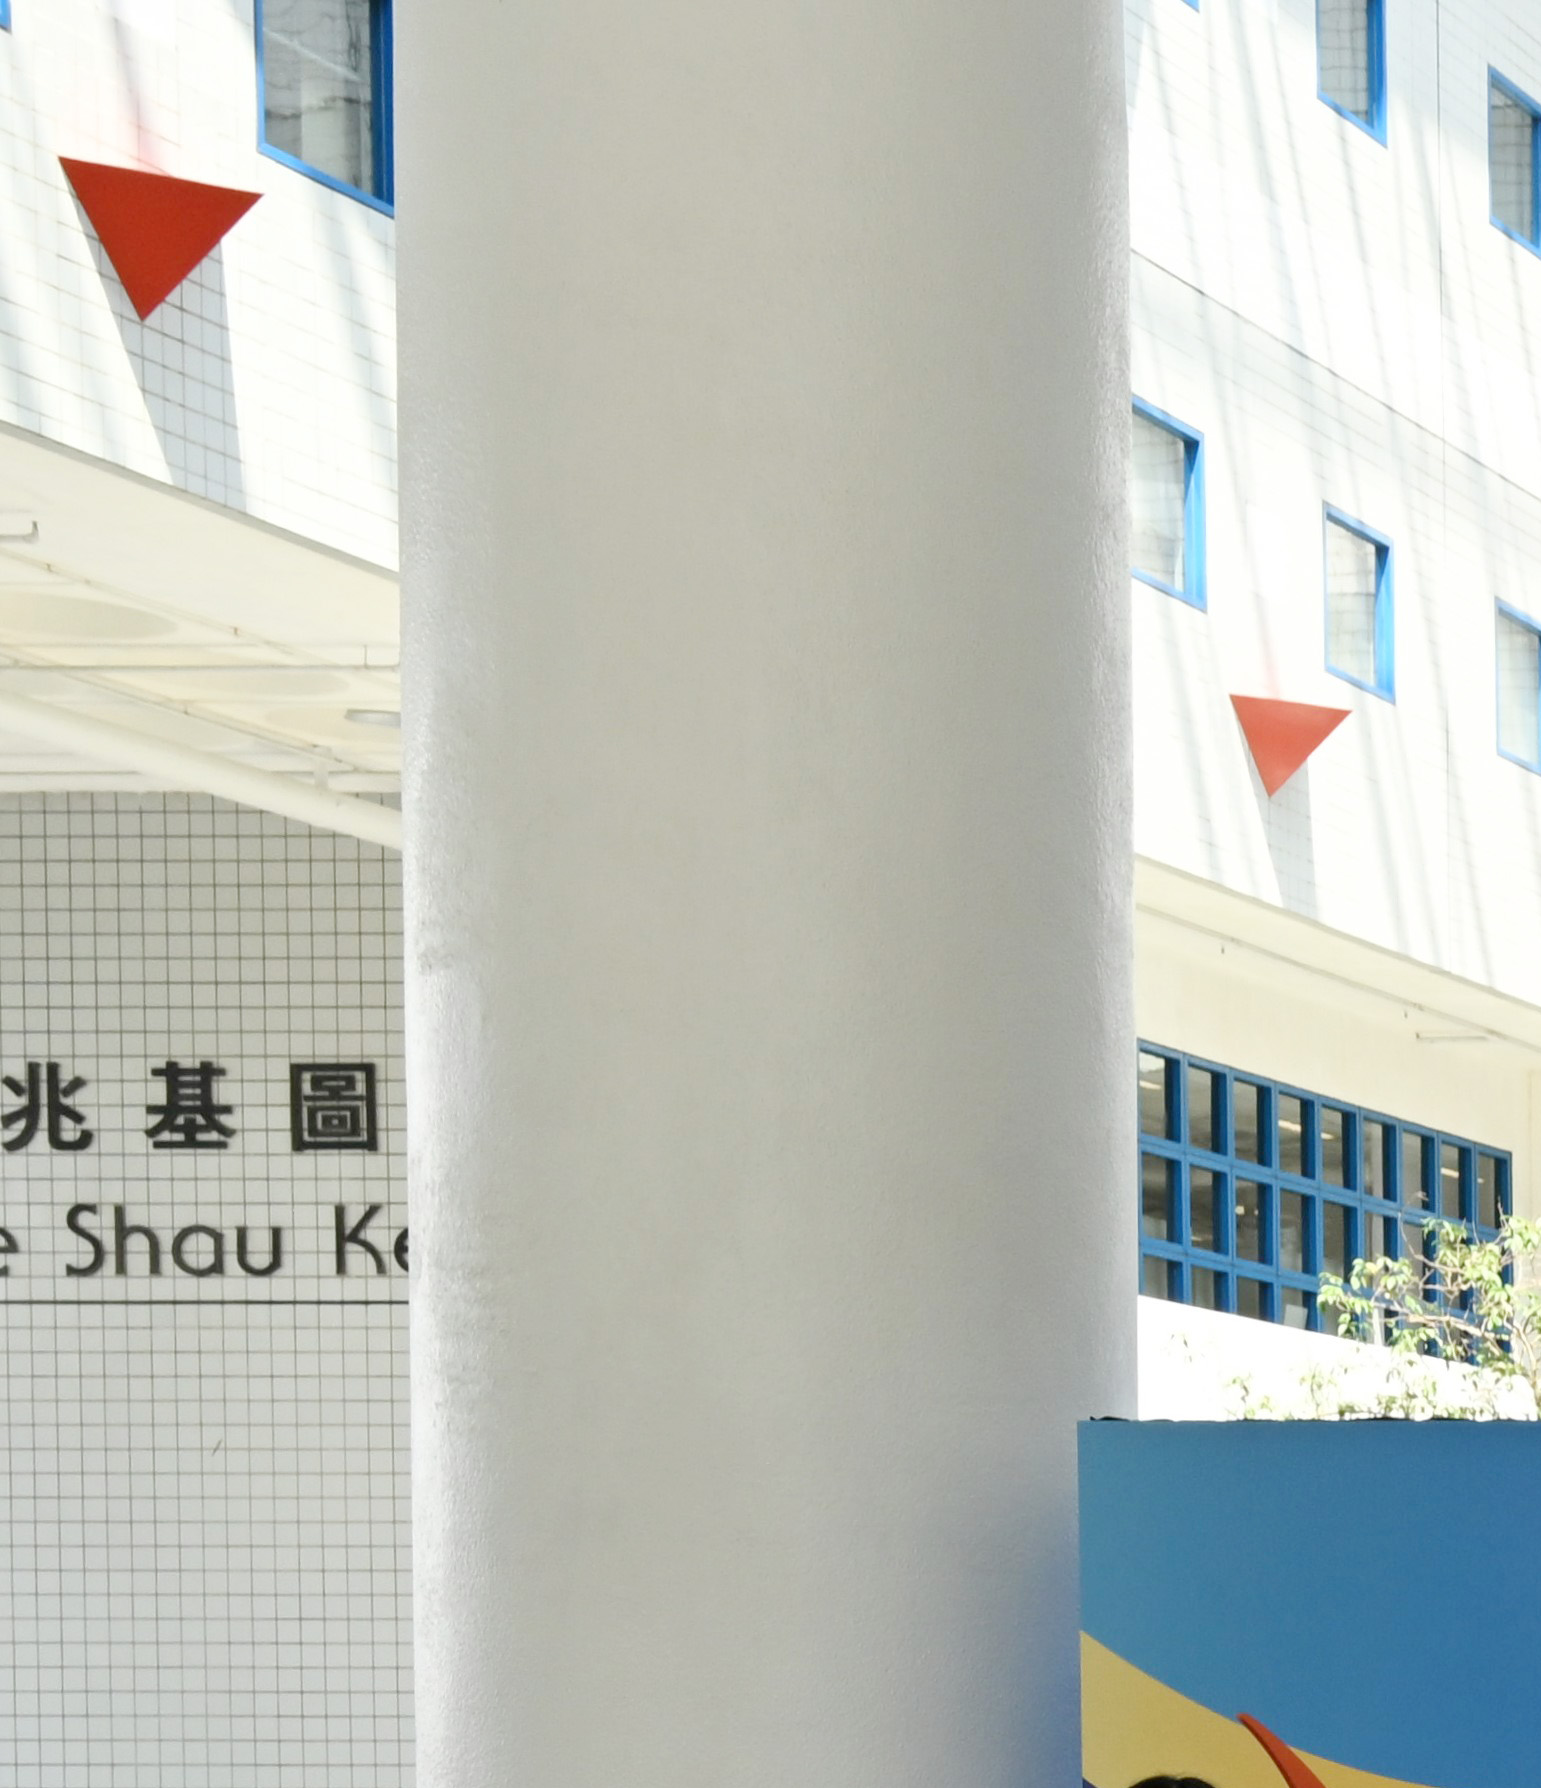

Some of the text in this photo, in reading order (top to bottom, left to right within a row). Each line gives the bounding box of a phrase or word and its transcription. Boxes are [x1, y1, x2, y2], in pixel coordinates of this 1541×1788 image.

[0, 1061, 379, 1152] 兆基圖
[66, 1204, 282, 1276] Shau
